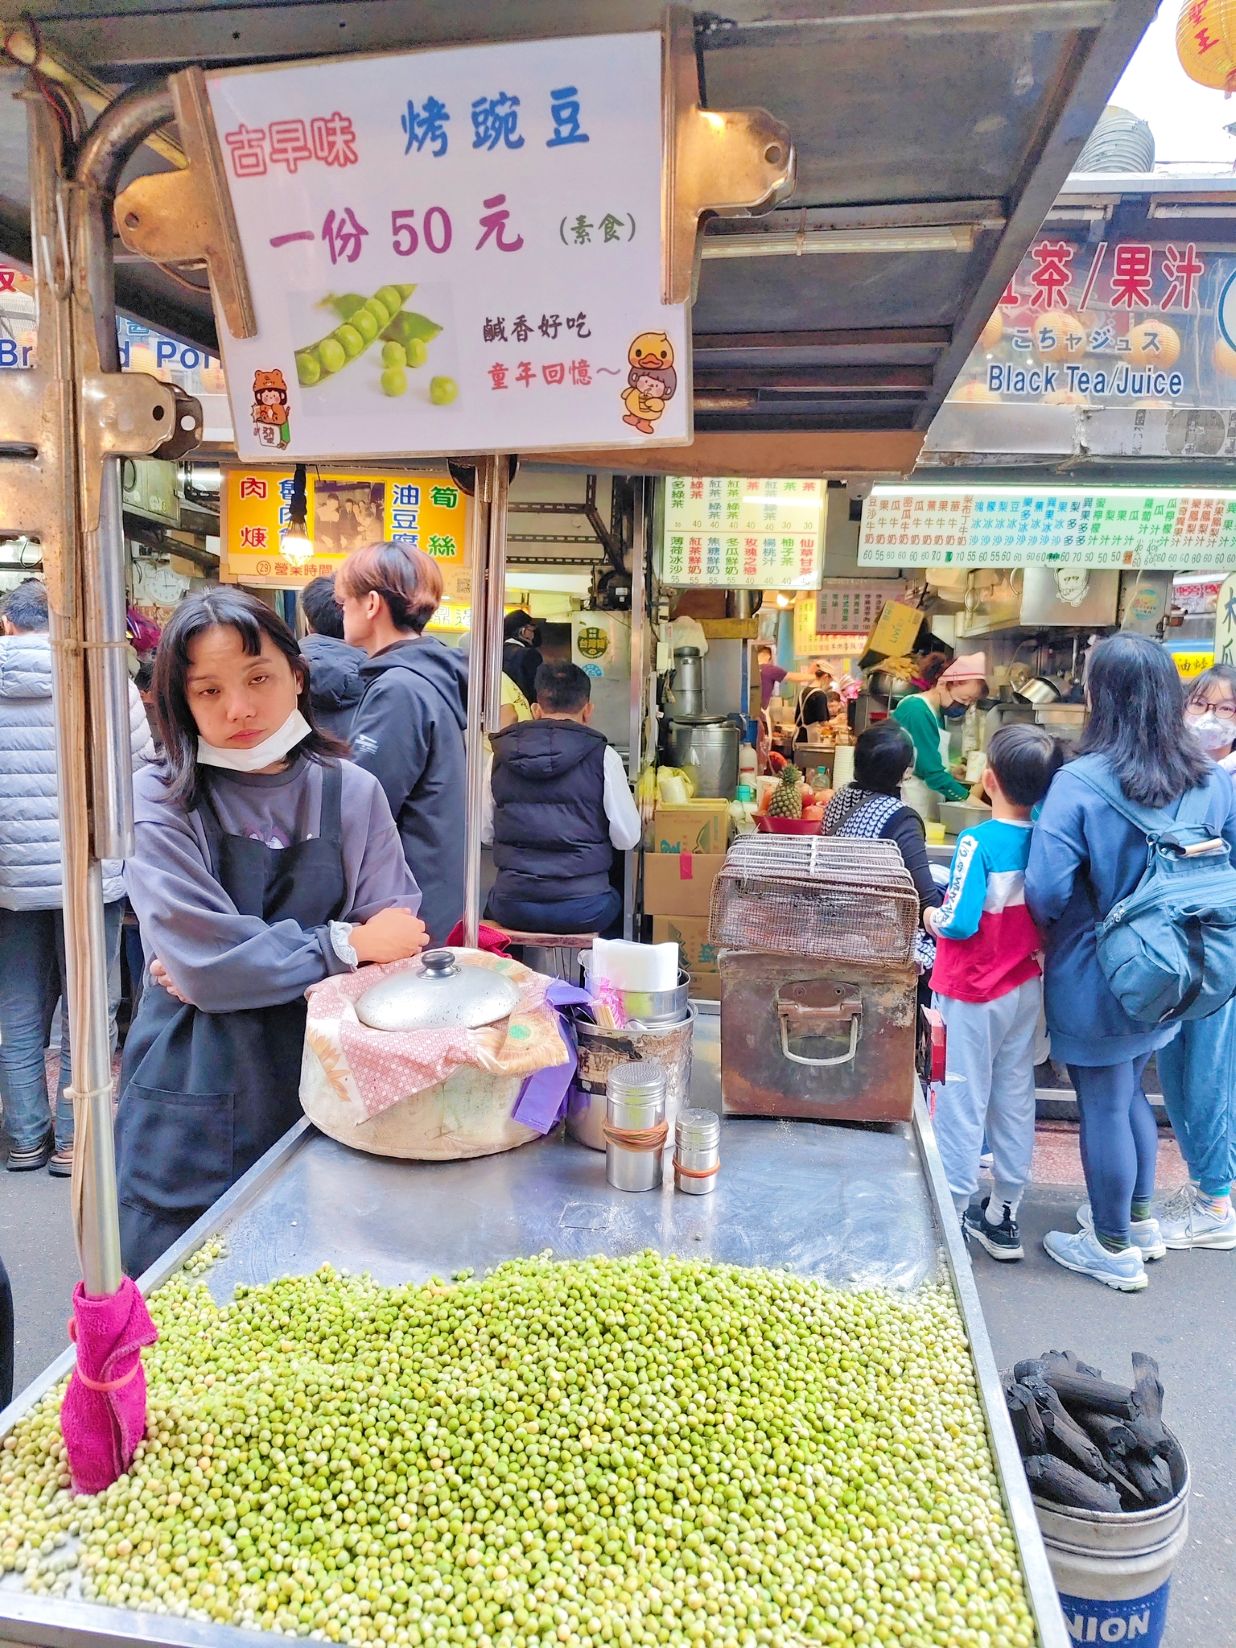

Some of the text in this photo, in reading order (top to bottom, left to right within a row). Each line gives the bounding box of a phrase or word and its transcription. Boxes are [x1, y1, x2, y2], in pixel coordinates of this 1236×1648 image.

[225, 86, 590, 177] 古早味 烤豌豆
[1000, 241, 1204, 311] 茶/果汁
[483, 311, 592, 343] 鹹香好吃
[988, 364, 1184, 395] Black Tea/Juice
[428, 486, 458, 557] 筍絲
[670, 537, 685, 574] 薄荷冰沙
[688, 537, 703, 575] 紅茶鮮奶
[725, 538, 740, 576] 冬瓜鮮奶
